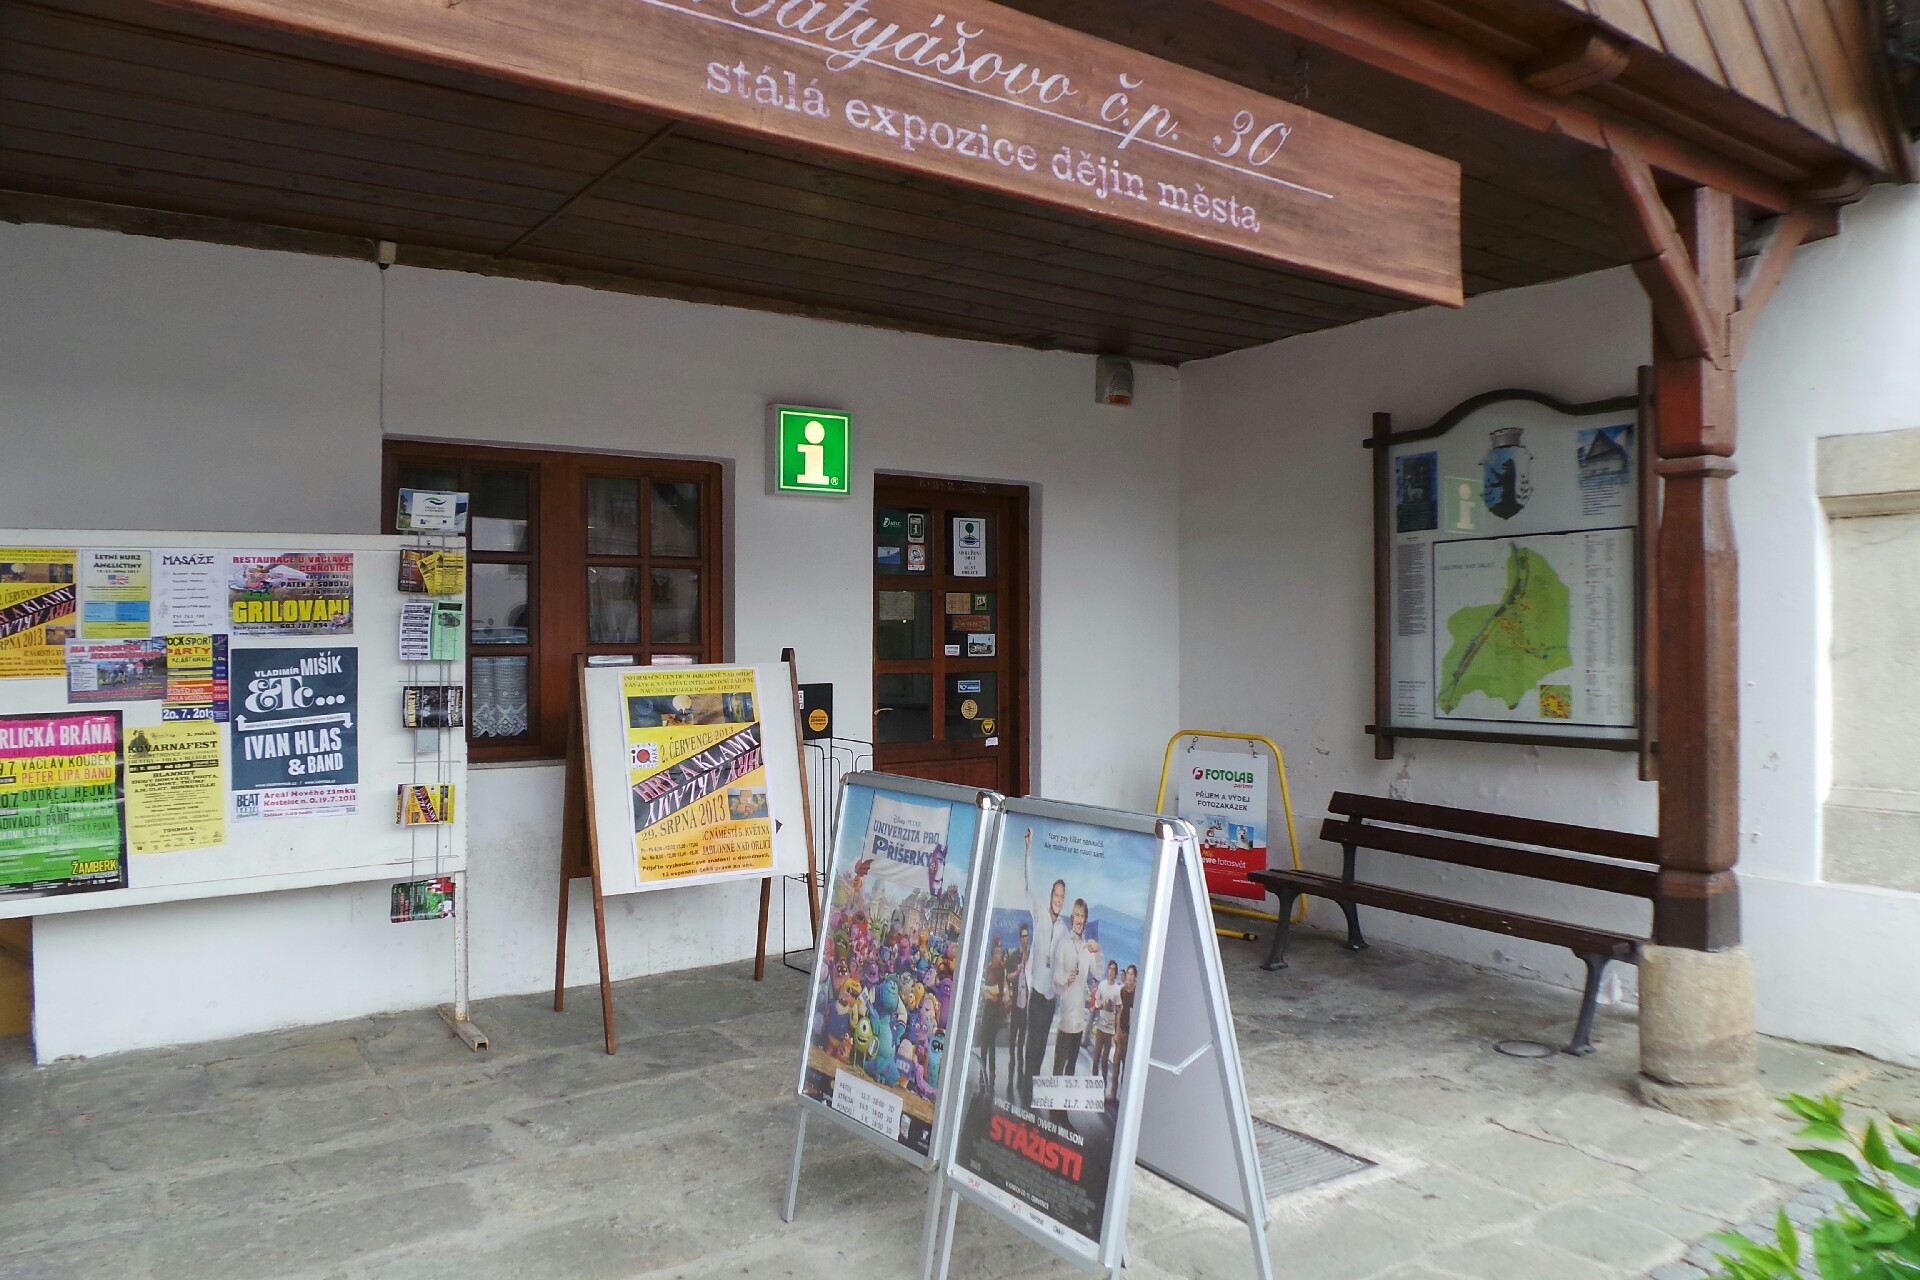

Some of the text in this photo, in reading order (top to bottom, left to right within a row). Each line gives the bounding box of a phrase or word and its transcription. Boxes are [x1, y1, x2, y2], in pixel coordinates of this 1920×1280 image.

[726, 0, 1079, 104] atyášovo
[1212, 109, 1293, 167] 30
[706, 60, 1262, 233] stálá expozice dějin města
[162, 553, 214, 566] MASÁŽE
[232, 556, 295, 564] RESTAURACE
[21, 587, 75, 614] KLAMY
[232, 595, 350, 623] GRILOVÁNÍ
[23, 628, 43, 648] 2013
[167, 636, 185, 646] OCK
[166, 646, 211, 656] PARTY
[254, 651, 343, 678] VLADIMÍR MIŠÍK
[163, 708, 214, 720] 20. 7. 2013
[59, 720, 113, 746] BRÁNA
[244, 727, 342, 761] IVAN HLAS
[669, 735, 713, 759] ČERVENCE
[715, 726, 735, 741] 2013
[21, 757, 64, 771] VÁCLAV
[68, 754, 111, 768] KOUBEK
[287, 753, 344, 776] & BAND
[632, 729, 760, 803] HRY A KLAMY
[21, 768, 112, 784] PETER LIPA BAND
[1205, 768, 1254, 784] FOTOLAB
[22, 786, 68, 802] ONDŘEJ
[74, 785, 113, 798] HEJMA
[236, 787, 356, 808] BEAT Areál Nového zámku
[263, 799, 299, 807] Kostelec
[339, 794, 356, 802] 2013
[1195, 791, 1220, 800] PŘÍJEM
[1228, 794, 1250, 803] VÝDEJ
[1197, 800, 1249, 812] FOTOZAKÁZEK
[46, 812, 70, 826] BRNO
[641, 794, 727, 842] 29. SRPNA 2013
[709, 825, 738, 840] NÁMĚSTÍ
[744, 823, 770, 836] KVĚTNA
[873, 820, 940, 846] UNIVERZITA PRO
[702, 836, 771, 856] JABLONNÉ NAD ORLICÍ
[872, 835, 934, 868] PŘÍŠERKY
[71, 859, 117, 875] ŽAMBERK
[1217, 858, 1247, 868] fotosvět
[1033, 1077, 1060, 1089] PONDĚLÍ
[1085, 1080, 1104, 1089] 20:00
[1032, 1096, 1104, 1110] NEDĚLE 21.7. 20:00
[1037, 1117, 1057, 1134] OWEN
[1057, 1124, 1084, 1147] WILSON
[989, 1113, 1084, 1182] STÁŽISTI
